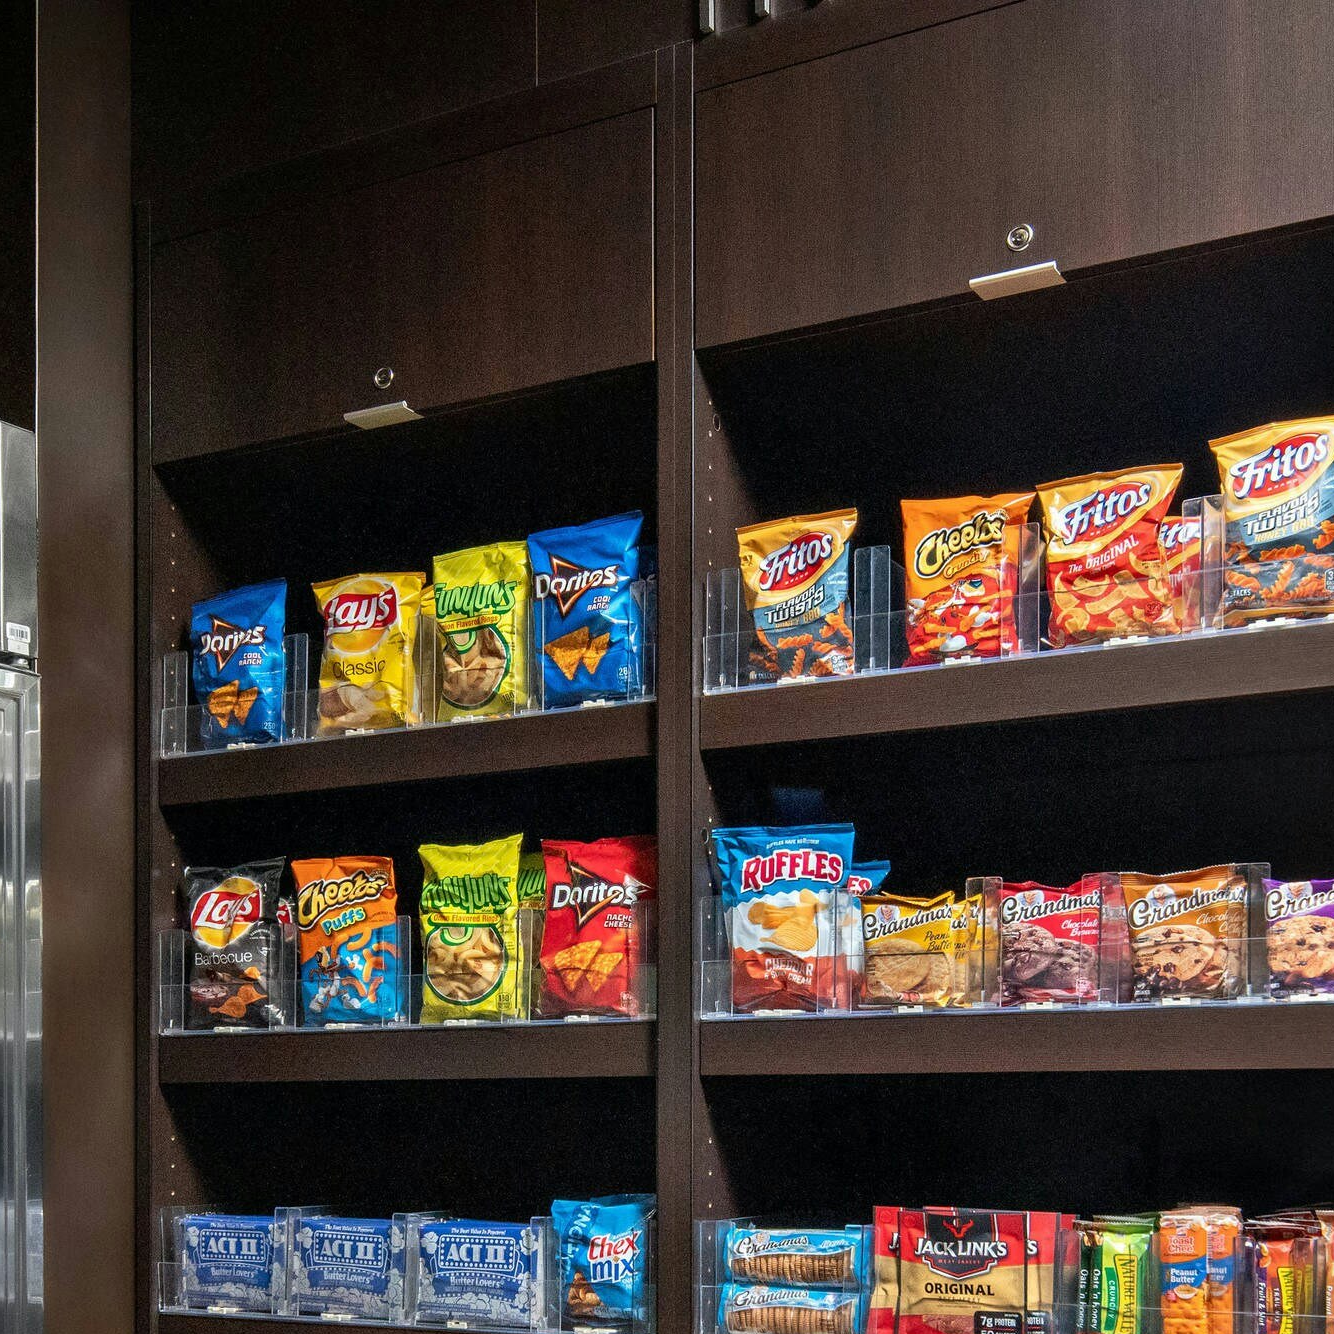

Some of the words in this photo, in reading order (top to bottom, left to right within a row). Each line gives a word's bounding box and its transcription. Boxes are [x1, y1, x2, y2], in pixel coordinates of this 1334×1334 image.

[1233, 432, 1330, 500] Fritos
[1060, 482, 1151, 546] Fritos
[1243, 494, 1321, 537] TWISTS
[1258, 492, 1310, 521] FLAVOR
[916, 513, 1004, 576] Cheetos
[1084, 535, 1140, 569] ORIGINAL
[759, 532, 833, 591] Fritos
[535, 566, 620, 600] Doritos
[323, 590, 393, 636] Lay's
[764, 584, 825, 625] TWISTS
[332, 657, 386, 680] Classic
[741, 849, 844, 891] RUFFLES
[298, 869, 388, 928] Cheetos
[552, 882, 639, 909] Doritos
[321, 907, 367, 936] Puffs
[861, 904, 953, 942] Grandma's
[194, 951, 254, 967] Barbecue
[764, 958, 814, 977] CHEDDAR
[206, 1237, 239, 1255] ACT
[241, 1238, 258, 1256] II
[320, 1239, 354, 1259] ACT
[355, 1241, 377, 1260] II
[446, 1243, 484, 1263] ACT
[485, 1245, 507, 1264] II
[587, 1231, 641, 1261] Chex
[913, 1237, 957, 1257] JACK
[958, 1238, 1008, 1259] LINK'S
[450, 1275, 474, 1287] Butter
[474, 1277, 501, 1288] Lovers
[590, 1258, 636, 1283] mix
[1170, 1268, 1198, 1277] Peanut
[1170, 1275, 1196, 1284] Butter
[924, 1282, 995, 1296] ORIGINAL
[979, 1315, 993, 1327] 7g
[994, 1317, 1016, 1327] PROTEIN
